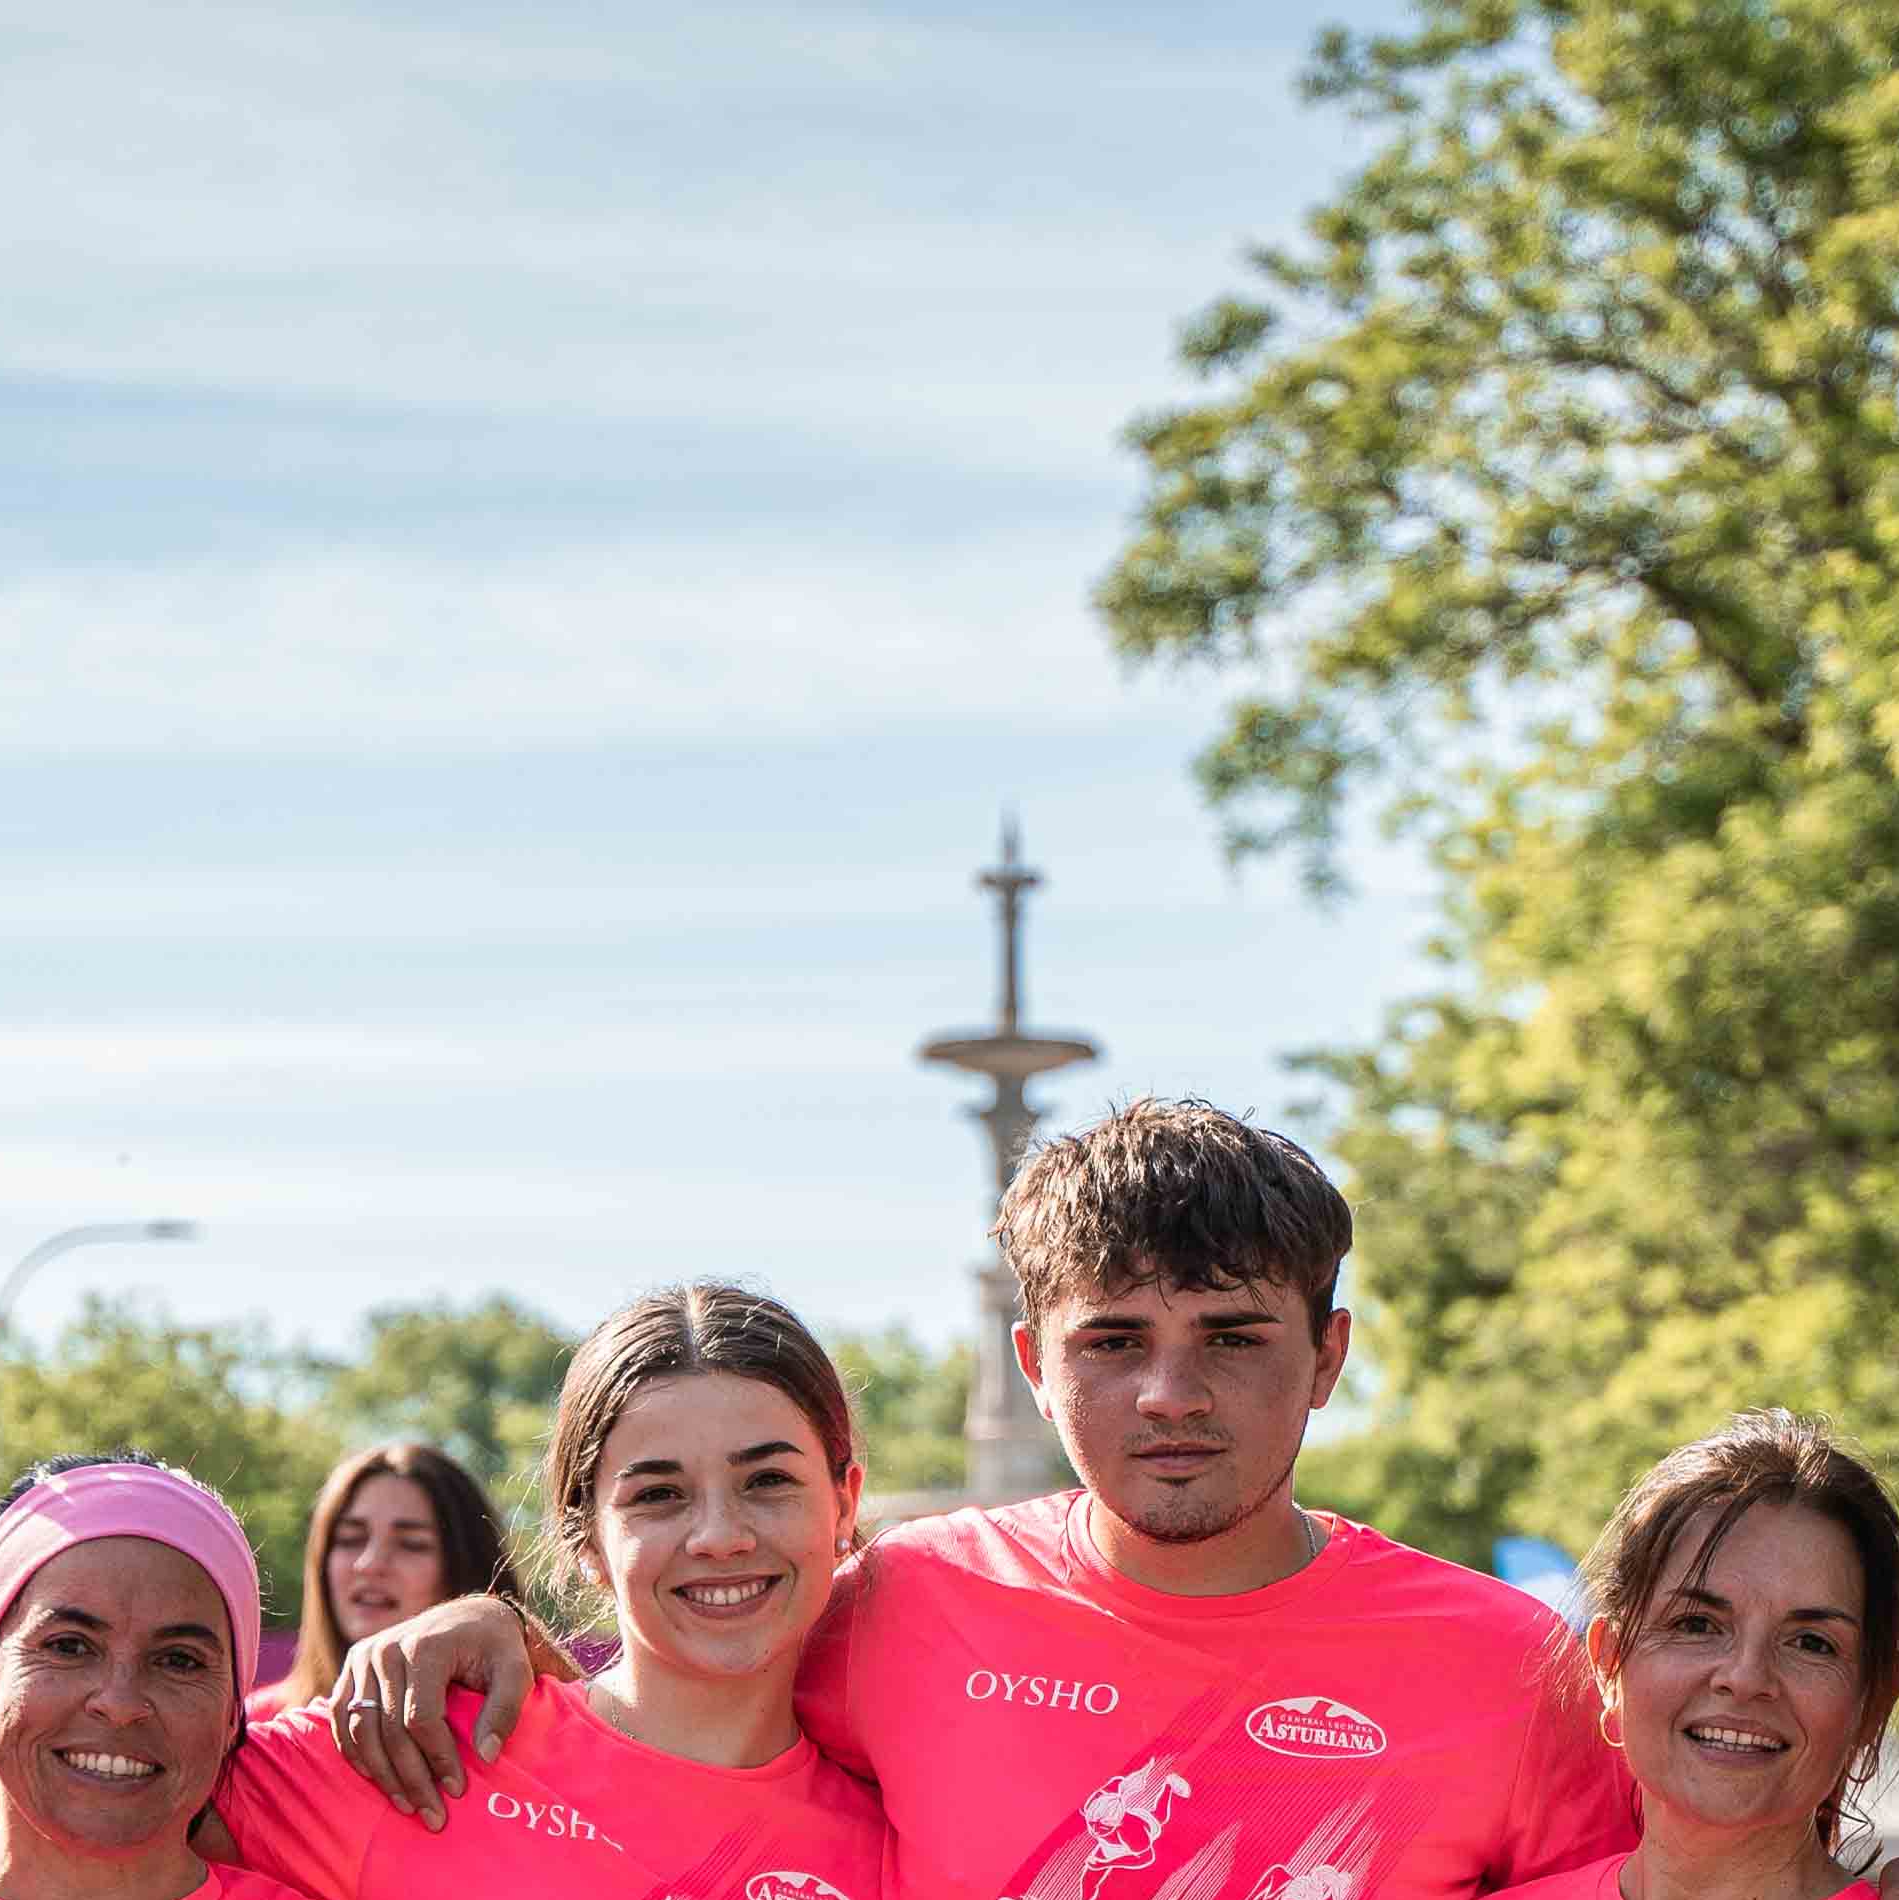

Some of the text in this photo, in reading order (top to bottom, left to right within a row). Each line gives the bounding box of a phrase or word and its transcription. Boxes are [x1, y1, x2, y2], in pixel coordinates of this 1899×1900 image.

[966, 1670, 1119, 1715] OYSHO
[1255, 1713, 1378, 1751] ASTURIANA
[488, 1792, 624, 1852] OYSH
